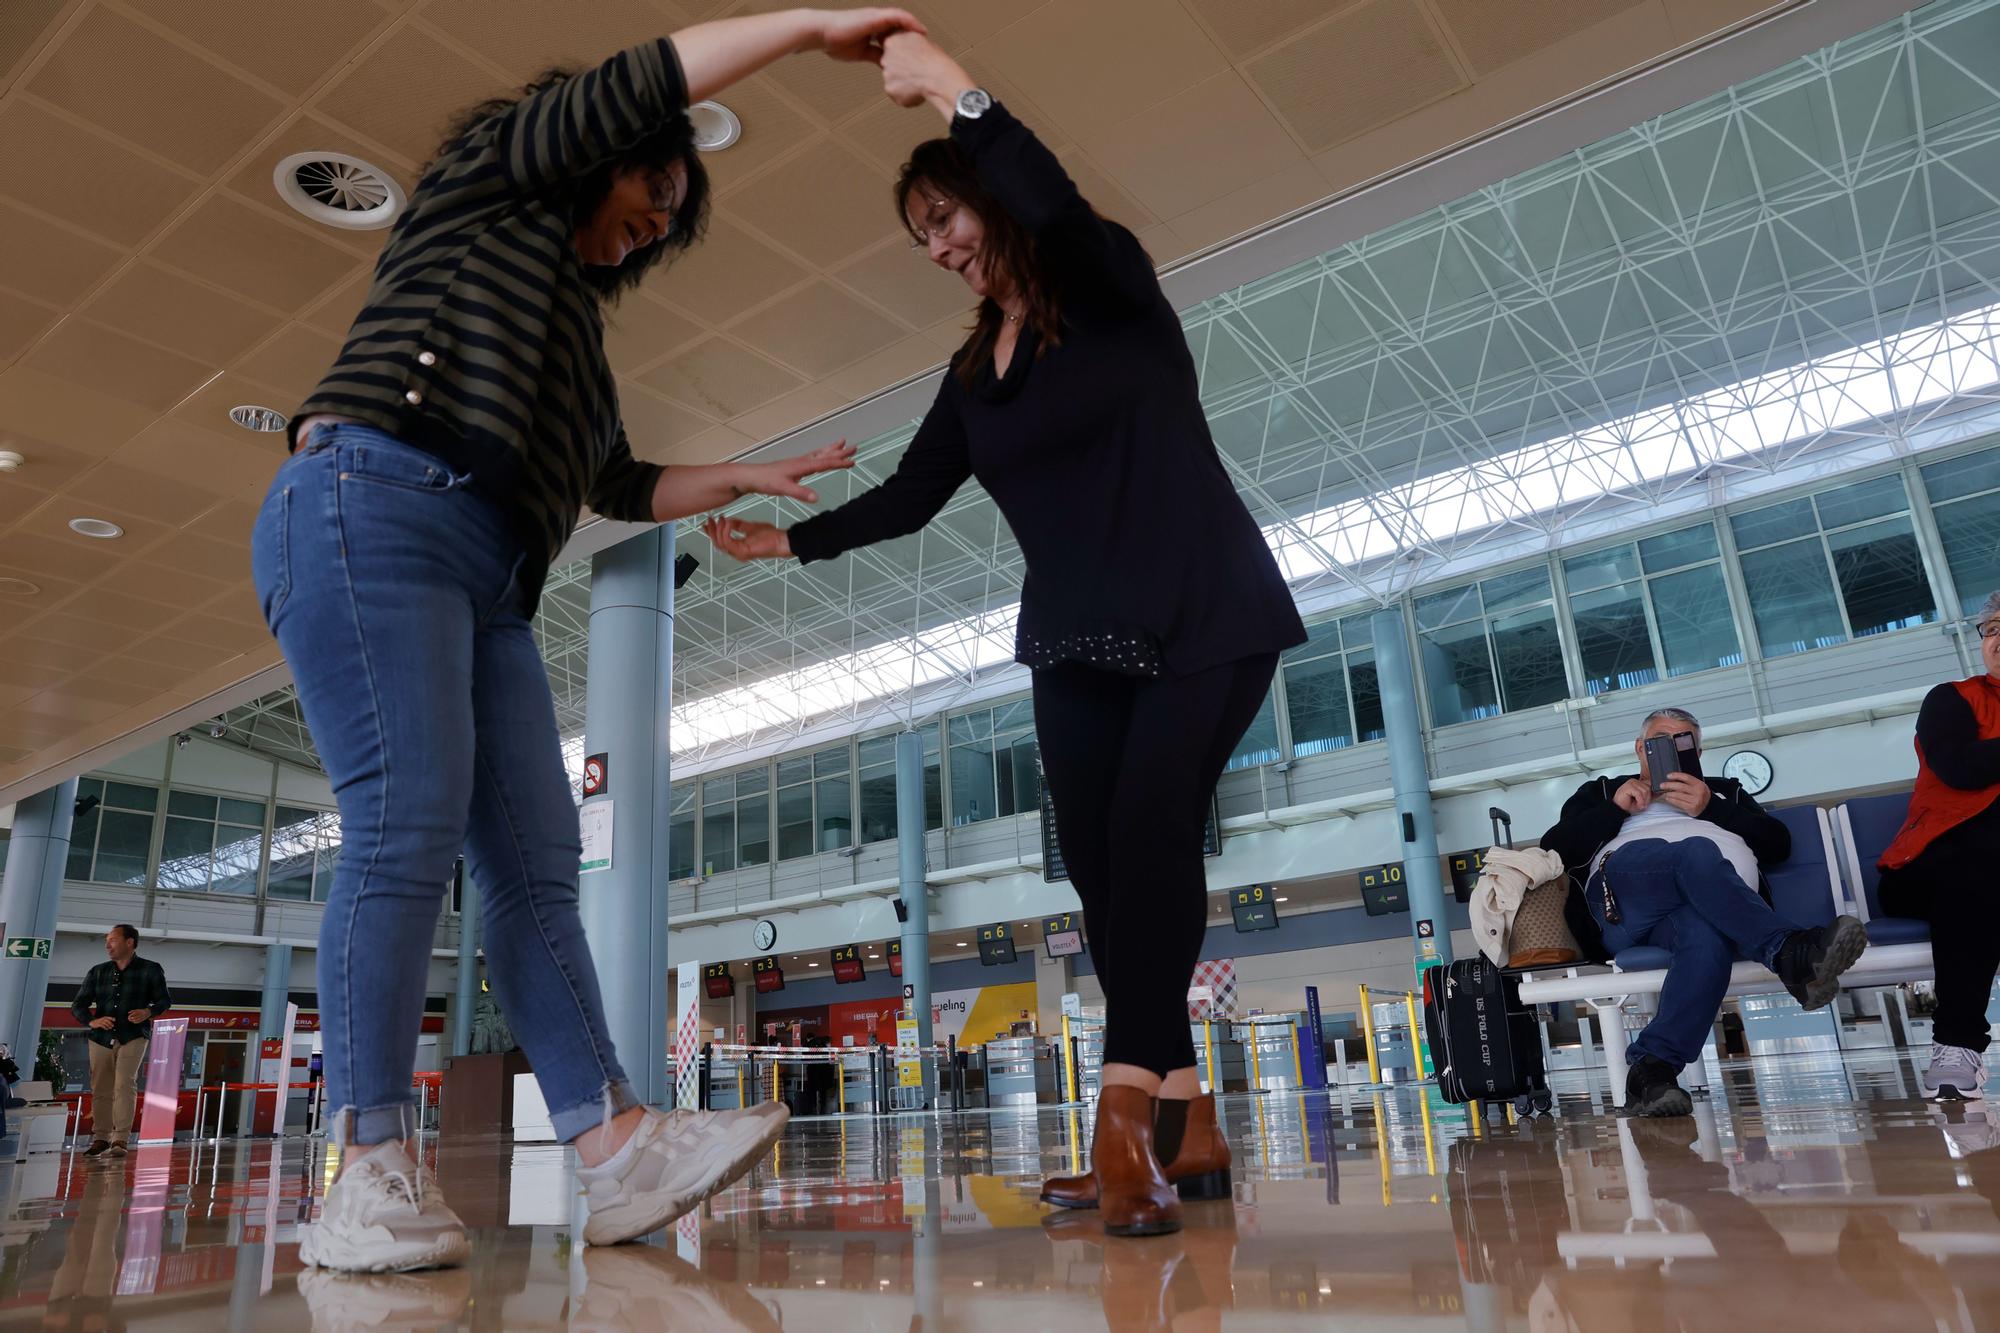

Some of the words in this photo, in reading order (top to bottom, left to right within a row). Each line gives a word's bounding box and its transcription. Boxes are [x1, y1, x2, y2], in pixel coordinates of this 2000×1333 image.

[1382, 867, 1401, 884] 10
[1254, 888, 1263, 902] 9
[1063, 917, 1071, 929] 7
[996, 926, 1004, 938] 6
[846, 948, 853, 959] 4
[718, 965, 724, 976] 2
[767, 959, 773, 969] 3
[1473, 964, 1482, 984] CUP
[931, 999, 966, 1013] ueling
[1476, 997, 1485, 1011] US
[853, 1012, 880, 1021] IBERIA
[1478, 1014, 1488, 1041] POLO
[1481, 1044, 1491, 1066] CUP
[1486, 1079, 1495, 1093] US
